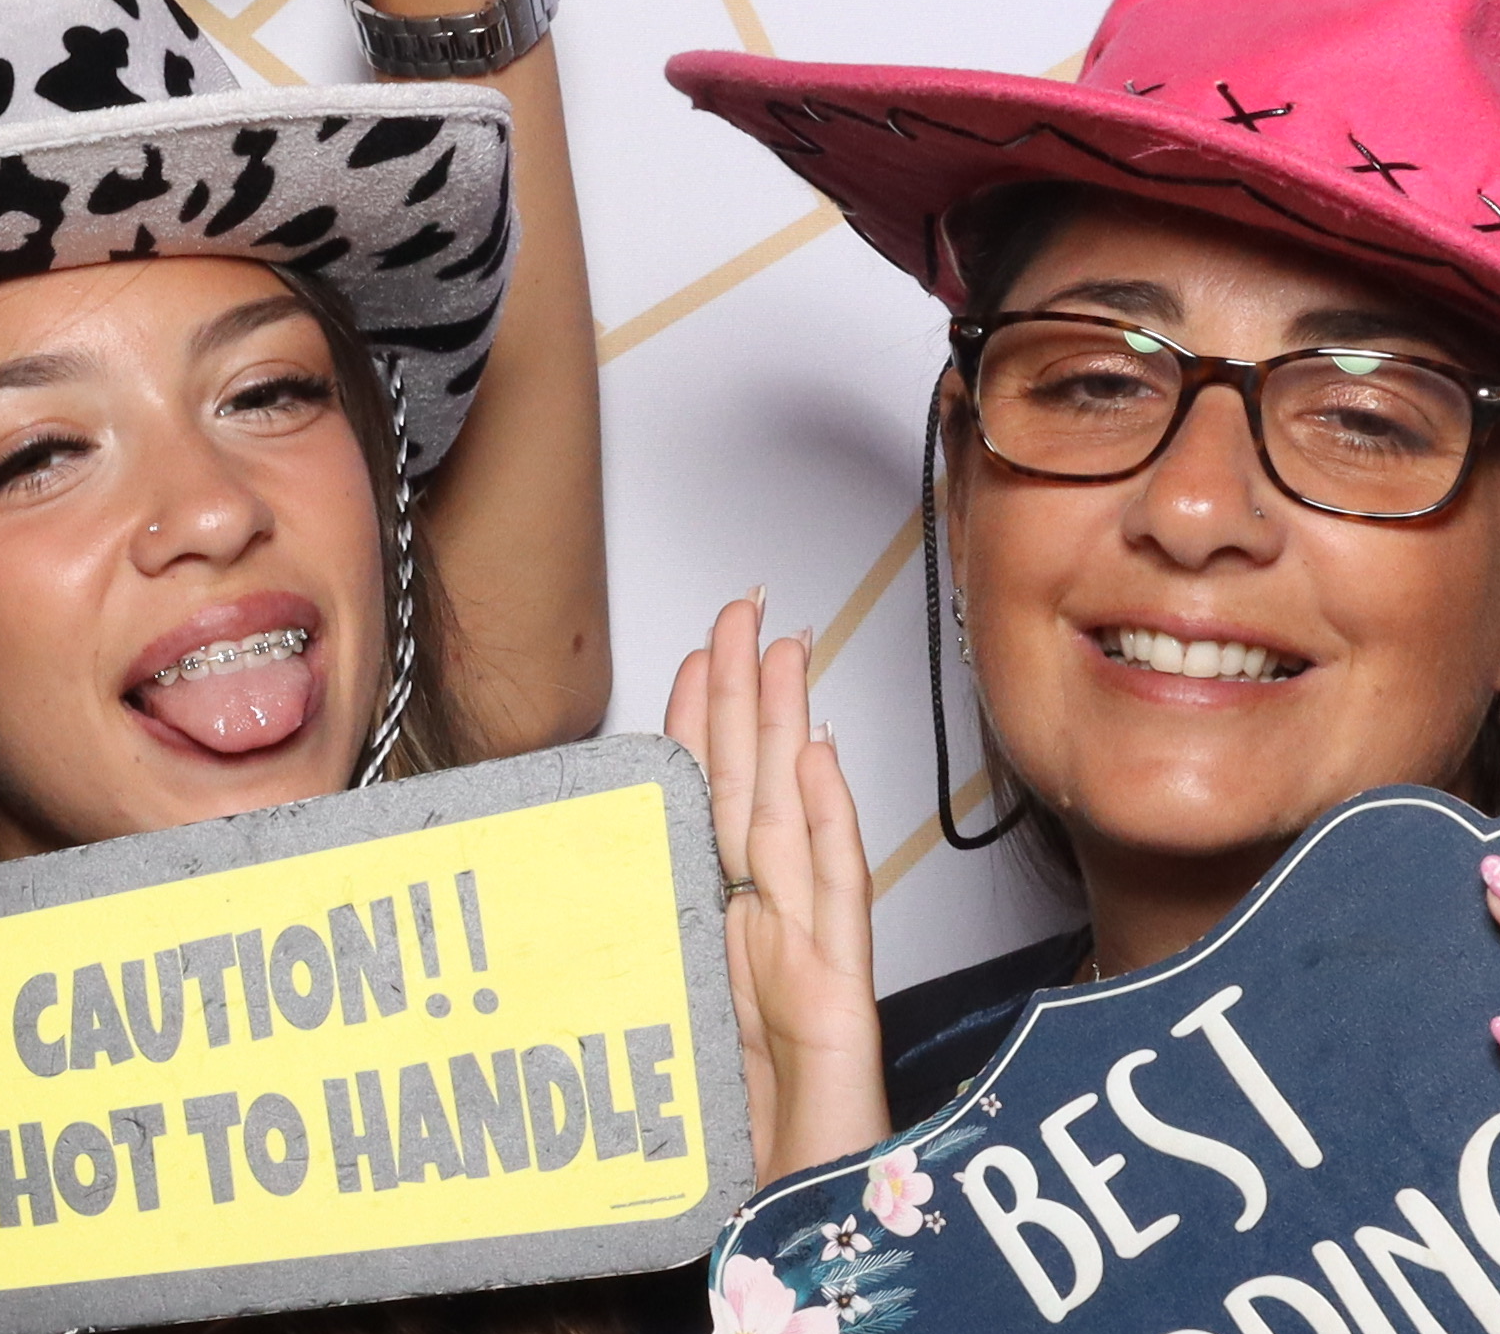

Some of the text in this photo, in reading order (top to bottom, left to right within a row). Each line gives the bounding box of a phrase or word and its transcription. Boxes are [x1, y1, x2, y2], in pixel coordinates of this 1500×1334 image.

[13, 870, 499, 1078] CAUTION!!
[184, 1090, 310, 1204] TO
[323, 1023, 689, 1193] HANDLE
[962, 985, 1323, 1323] BEST
